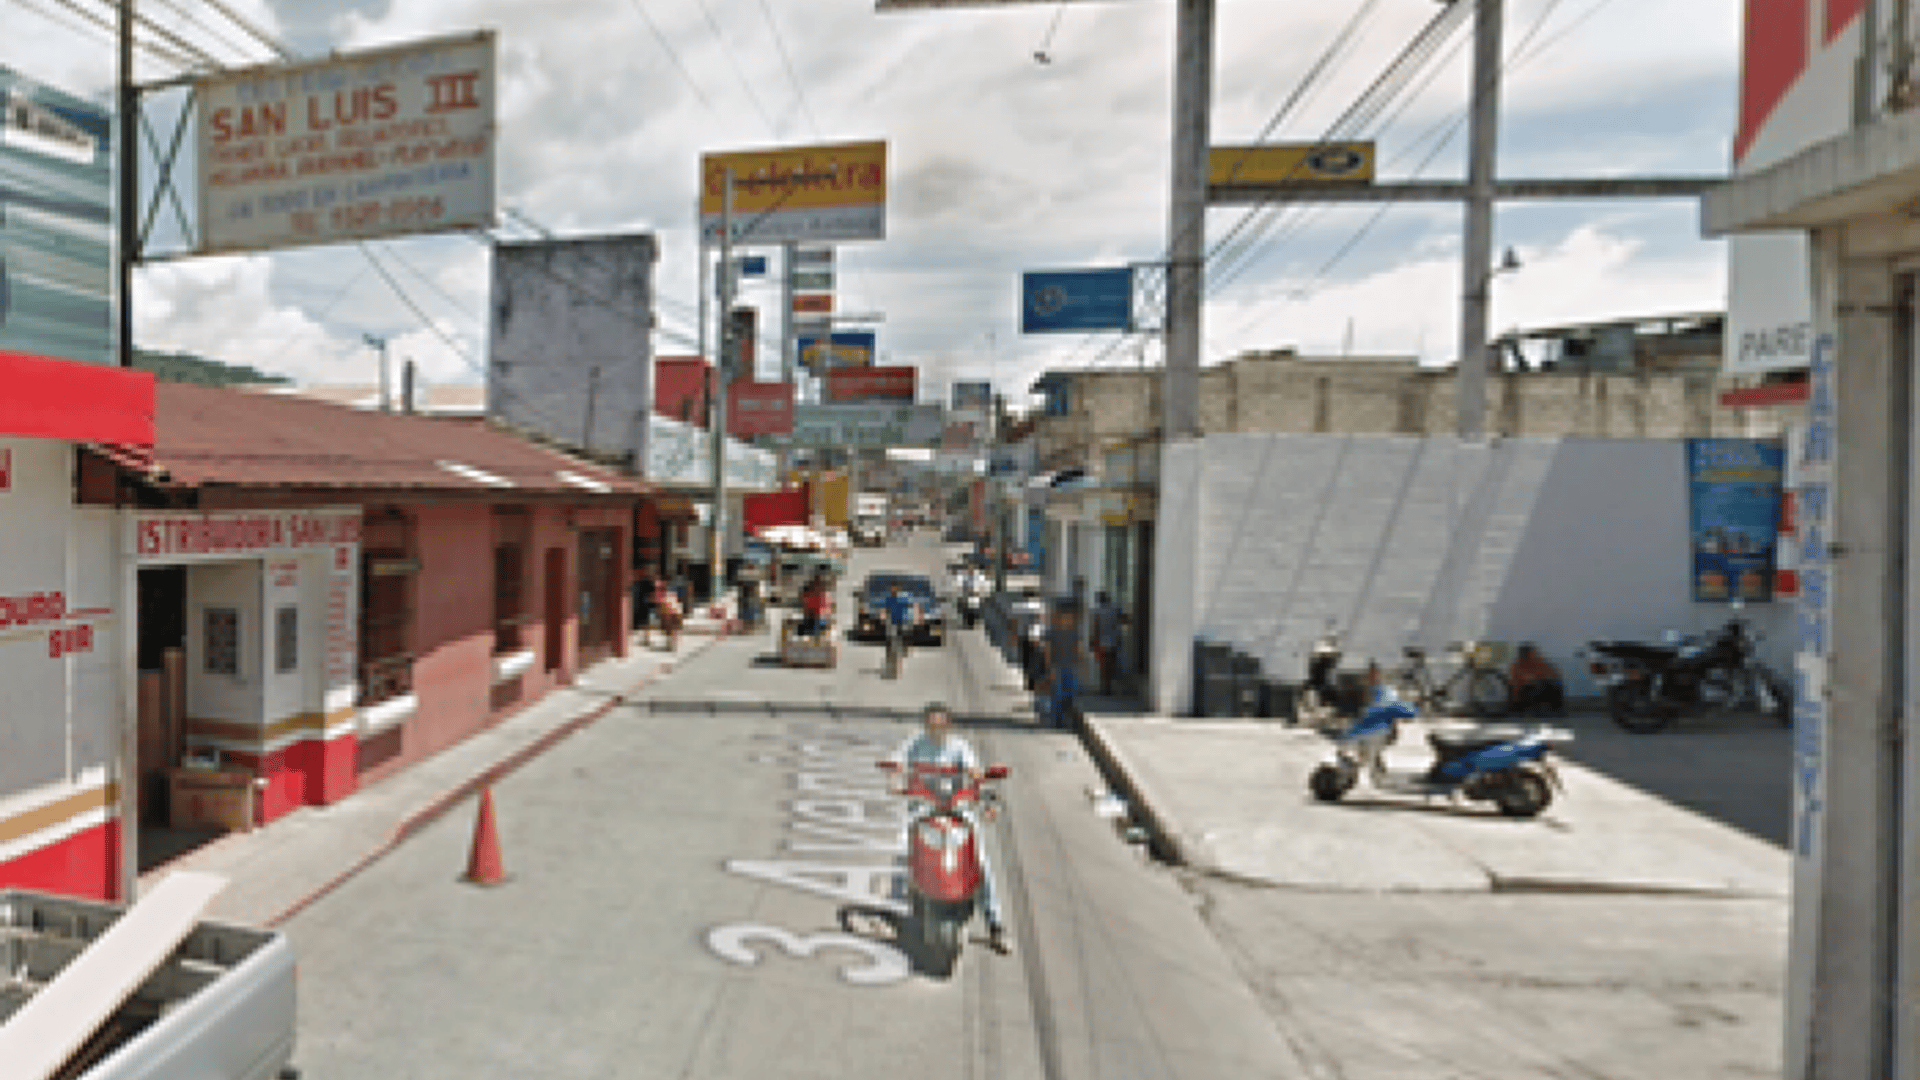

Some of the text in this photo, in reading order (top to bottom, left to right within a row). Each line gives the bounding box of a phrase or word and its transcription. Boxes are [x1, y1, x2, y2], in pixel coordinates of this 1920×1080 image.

[211, 102, 287, 144] SAN
[307, 83, 398, 131] LUIS
[424, 70, 481, 114] III
[1803, 331, 1834, 464] CAR
[1798, 482, 1829, 659] WASH
